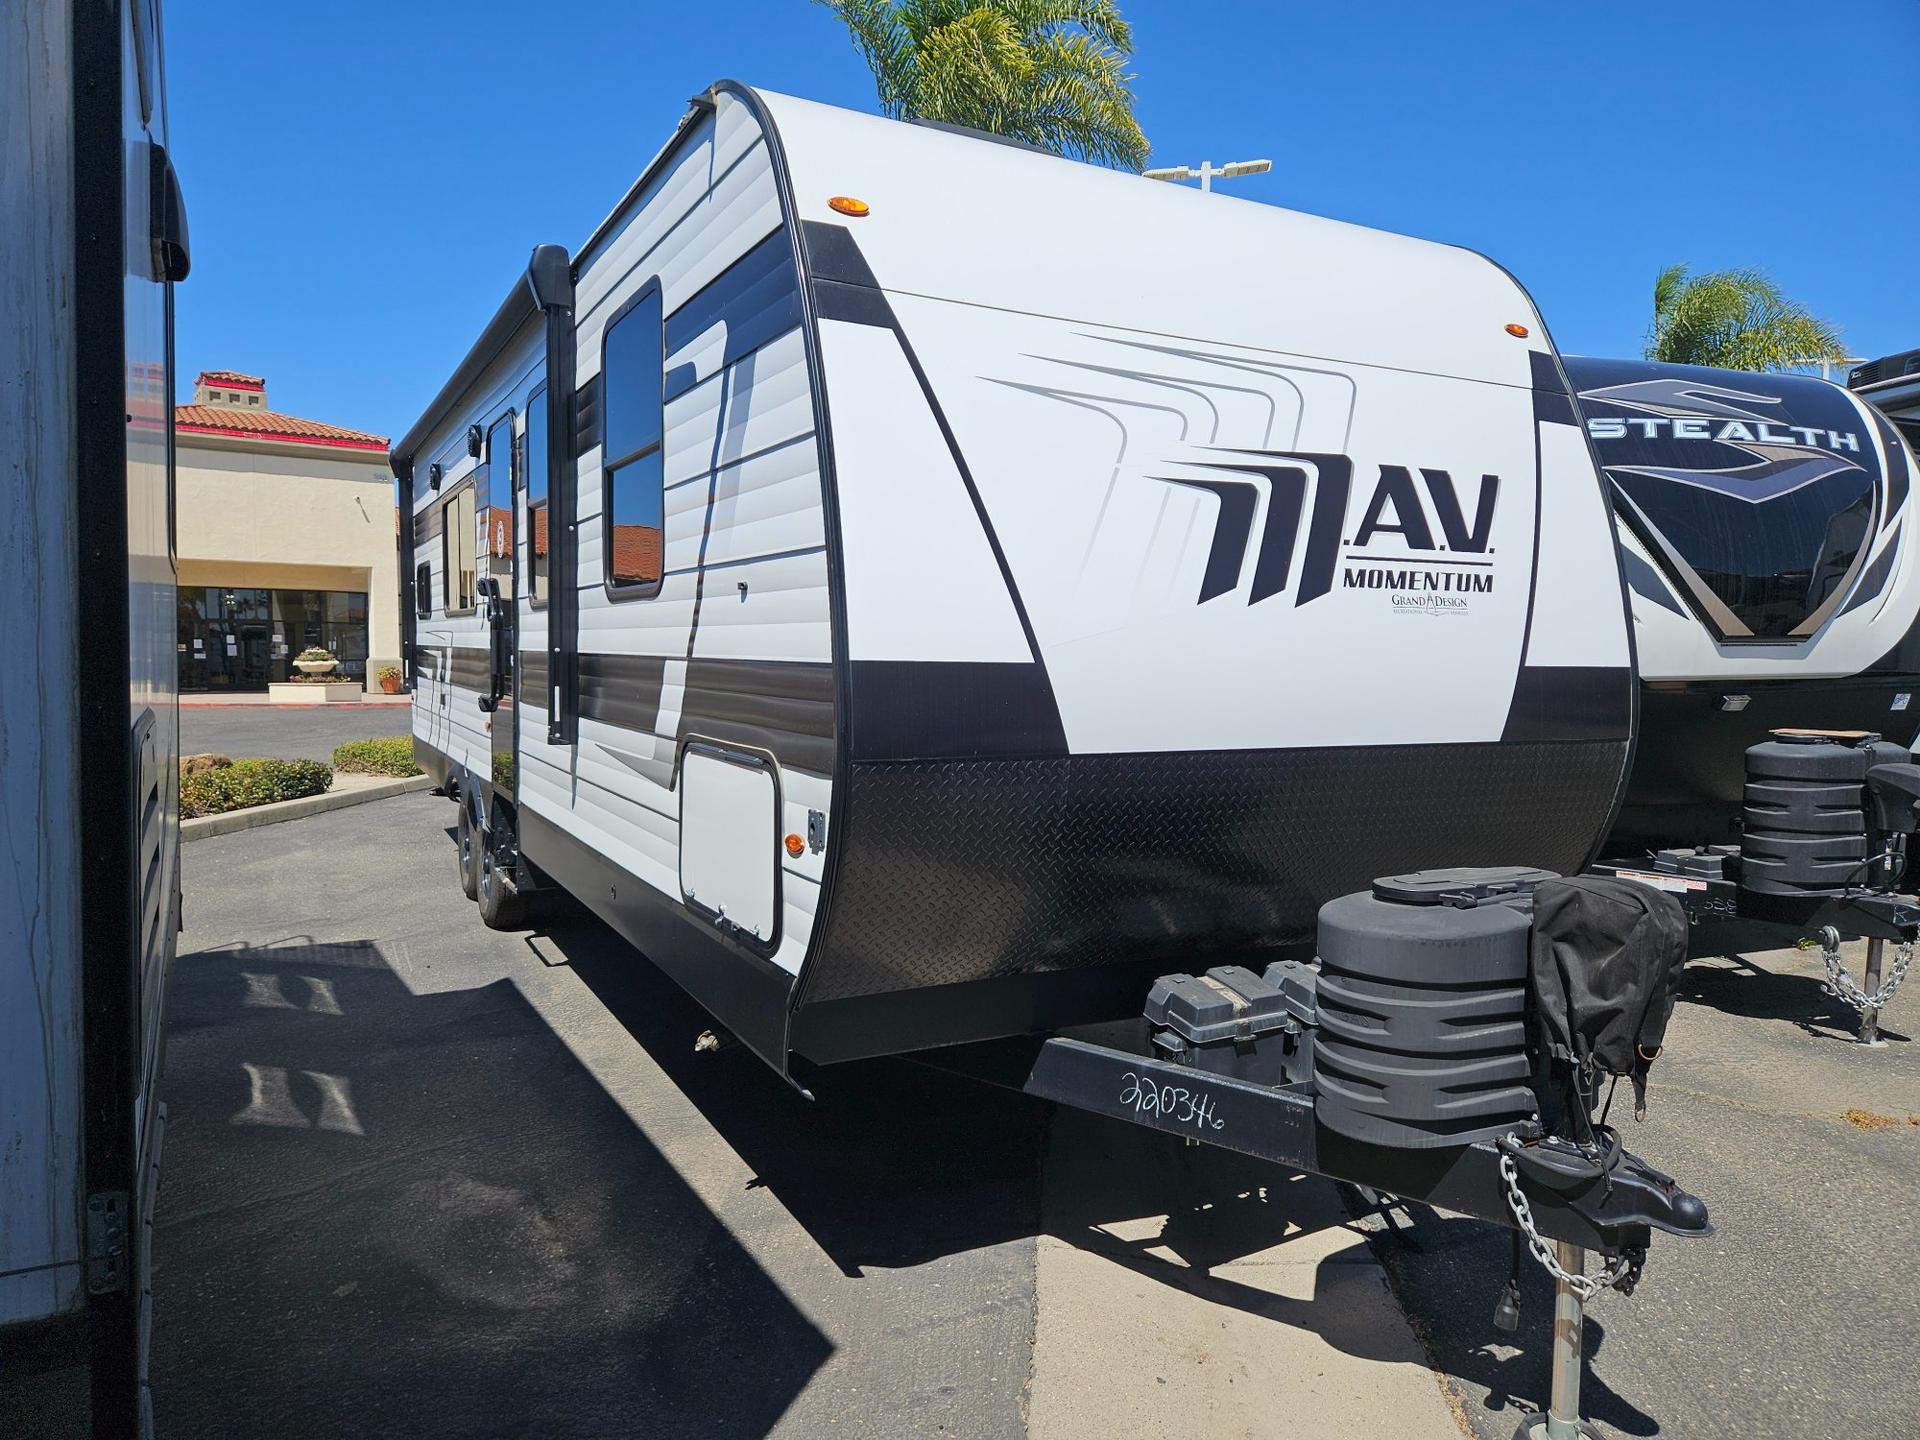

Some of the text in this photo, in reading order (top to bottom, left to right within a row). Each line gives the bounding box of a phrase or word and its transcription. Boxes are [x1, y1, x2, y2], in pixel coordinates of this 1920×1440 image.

[1587, 417, 1861, 453] STEALTH
[1343, 567, 1494, 593] MOMENTUM
[1391, 594, 1468, 608] GRAND DESIGN
[1118, 1071, 1225, 1131] 220346
